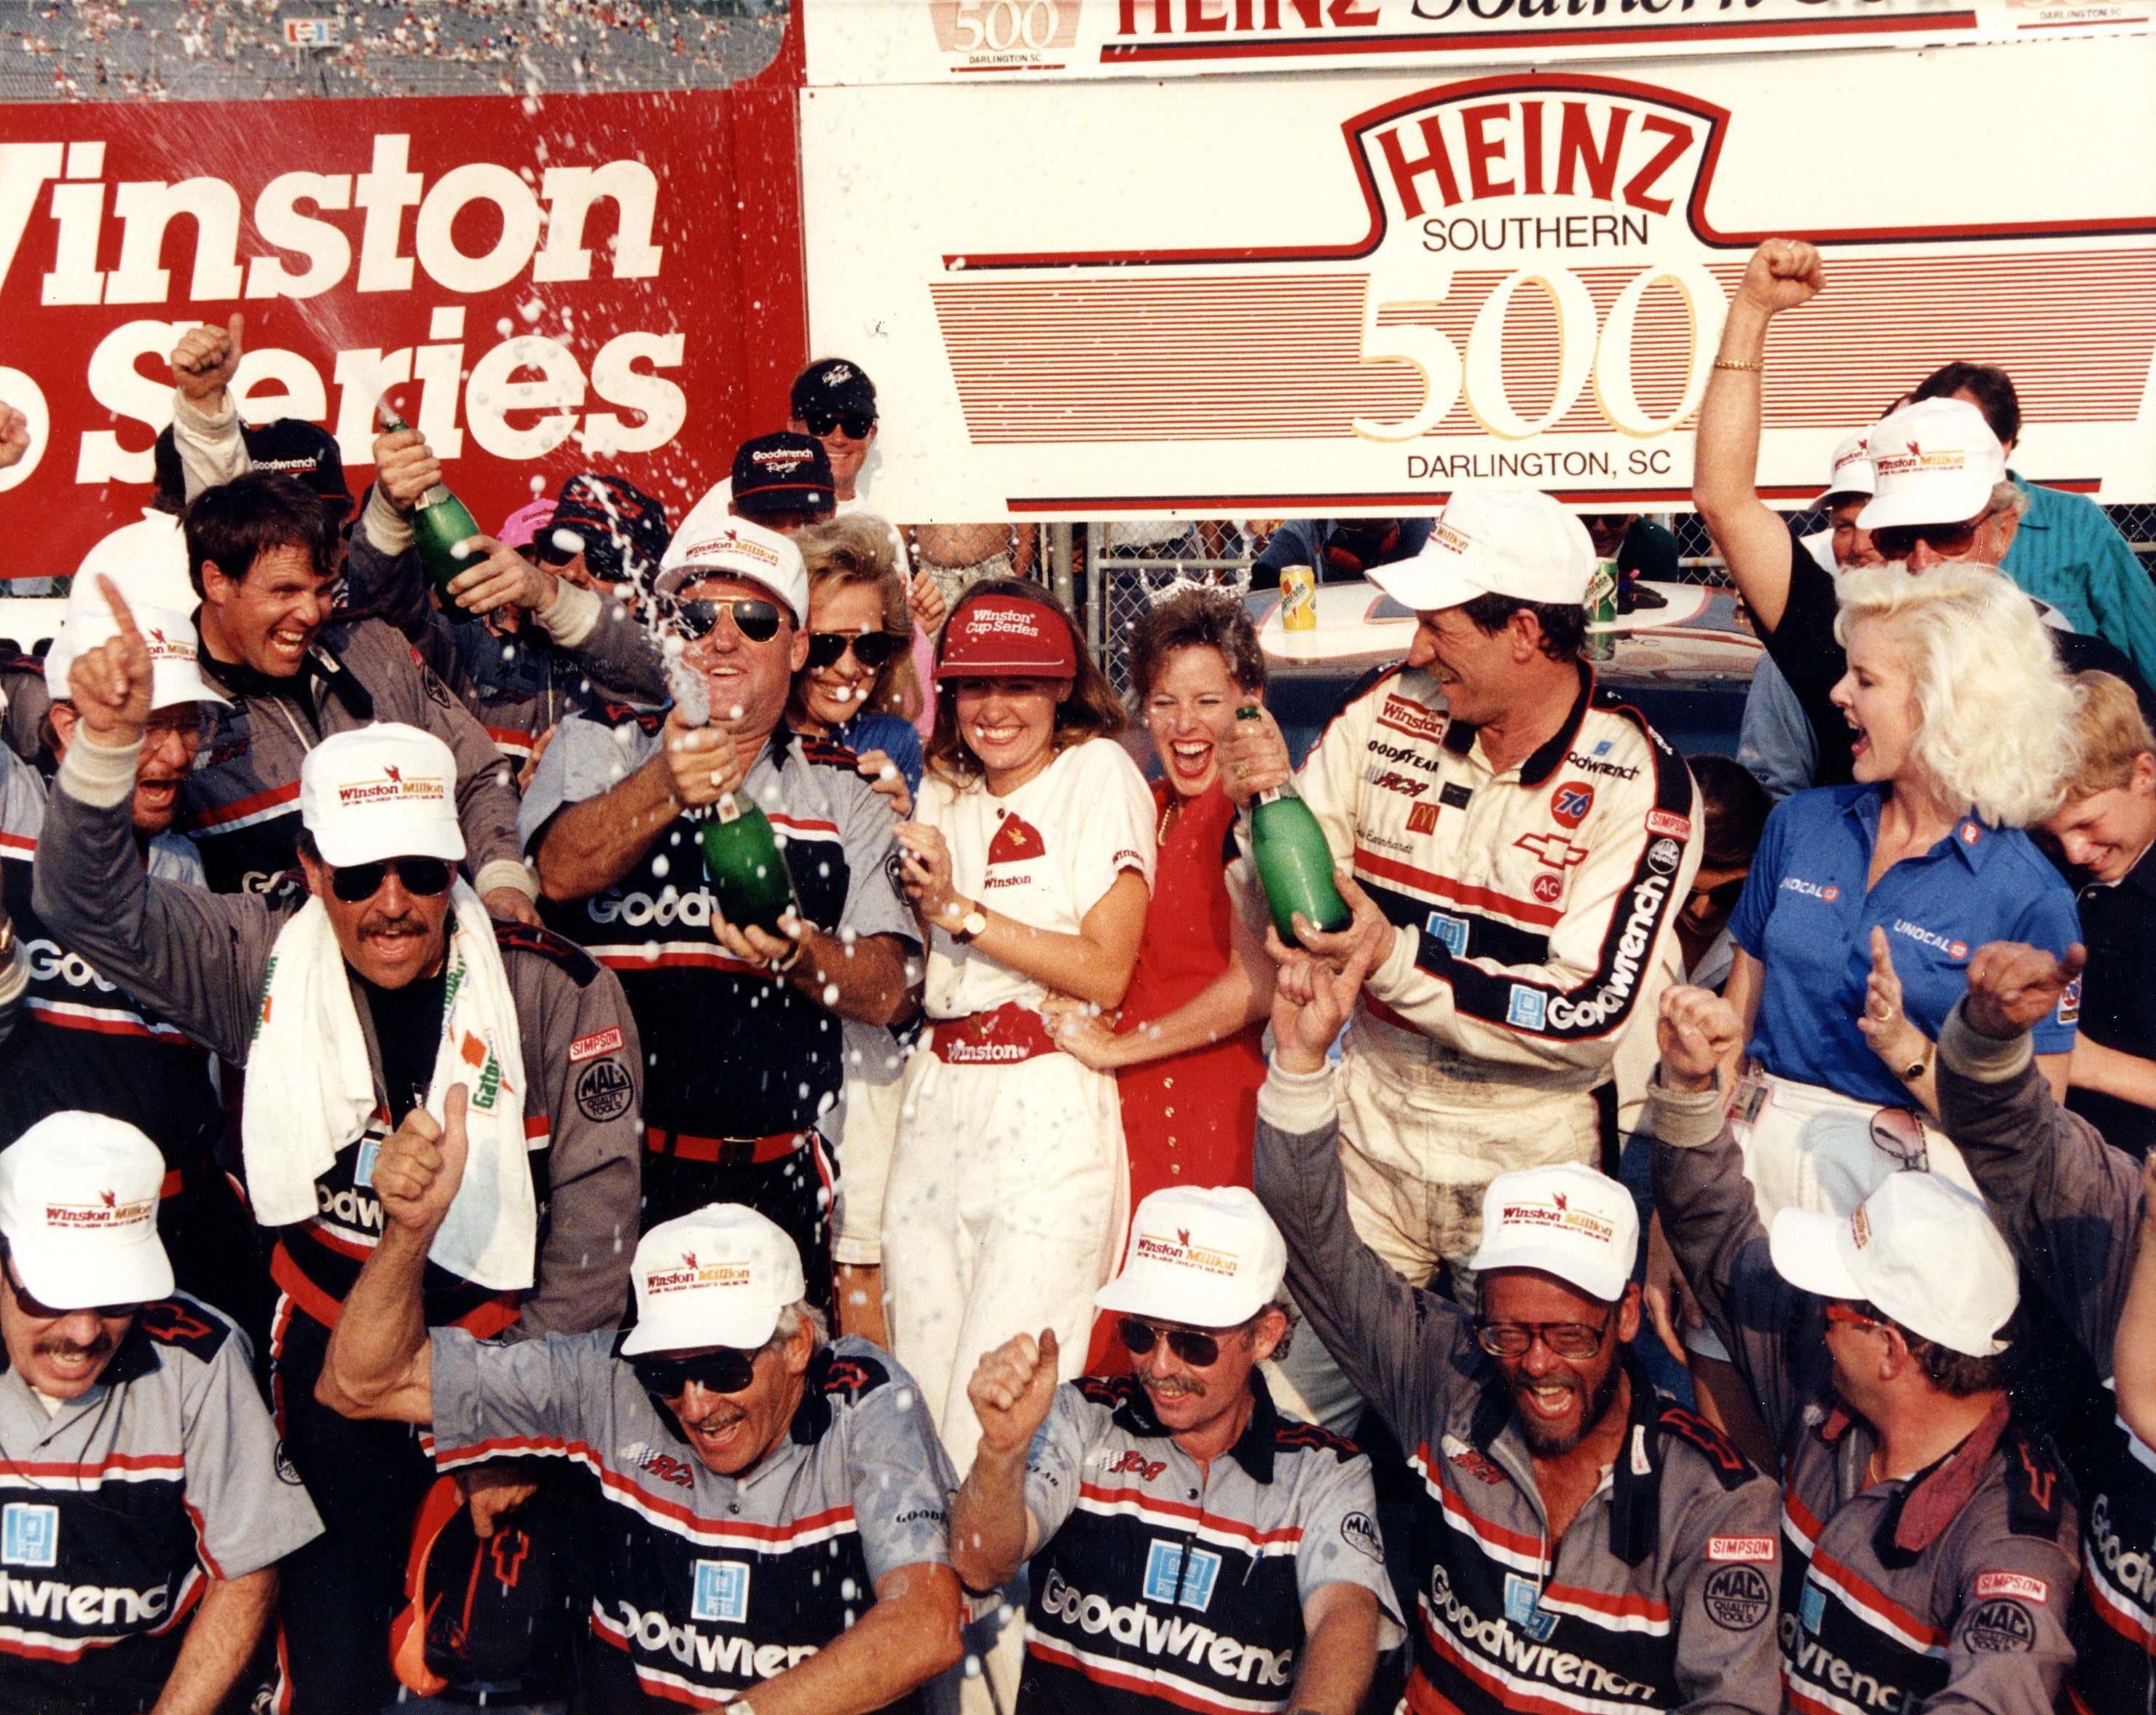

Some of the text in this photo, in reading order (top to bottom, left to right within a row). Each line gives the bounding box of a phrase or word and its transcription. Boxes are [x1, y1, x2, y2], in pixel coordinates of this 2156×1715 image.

[953, 0, 1061, 53] 500
[1374, 101, 1695, 221] HEINZ
[1422, 213, 1648, 252] SOUTHERN
[1352, 264, 1732, 442] 500
[76, 306, 686, 484] Series
[251, 457, 317, 471] Goodwrench
[752, 449, 814, 461] Goodwrench
[1407, 450, 1672, 479] DARLINGTON, SC
[1877, 458, 1916, 471] Winston
[966, 620, 1039, 637] Cup Series
[973, 609, 1031, 624] Winston
[1382, 701, 1444, 736] Winston
[1566, 750, 1641, 781] odwrench
[338, 782, 444, 801] Winston Million
[1554, 790, 1592, 817] 76
[984, 874, 1031, 890] Winston
[1535, 879, 1559, 898] AC
[1779, 876, 1822, 898] NOCAL
[1894, 918, 1949, 951] UNOCAL
[1546, 874, 1670, 1030] Goodwrench
[573, 1030, 618, 1056] SIMPSON
[947, 1040, 1019, 1061] Winston
[471, 1055, 500, 1110] Gator
[582, 1064, 627, 1097] MAC
[46, 1204, 152, 1221] Winston Million
[1503, 1206, 1613, 1237] Winston Million
[1138, 1238, 1183, 1258] Winston
[647, 1273, 695, 1289] Winston
[1713, 1540, 1771, 1555] SIMPSON
[0, 1571, 170, 1625] wrenc
[1710, 1570, 1766, 1601] MAC
[1980, 1574, 2042, 1594] SIMPSON
[1714, 1601, 1759, 1615] QUALITY
[1974, 1604, 2029, 1639] MAC
[618, 1600, 820, 1679] oodwren
[1042, 1567, 1294, 1687] Goodwrenc
